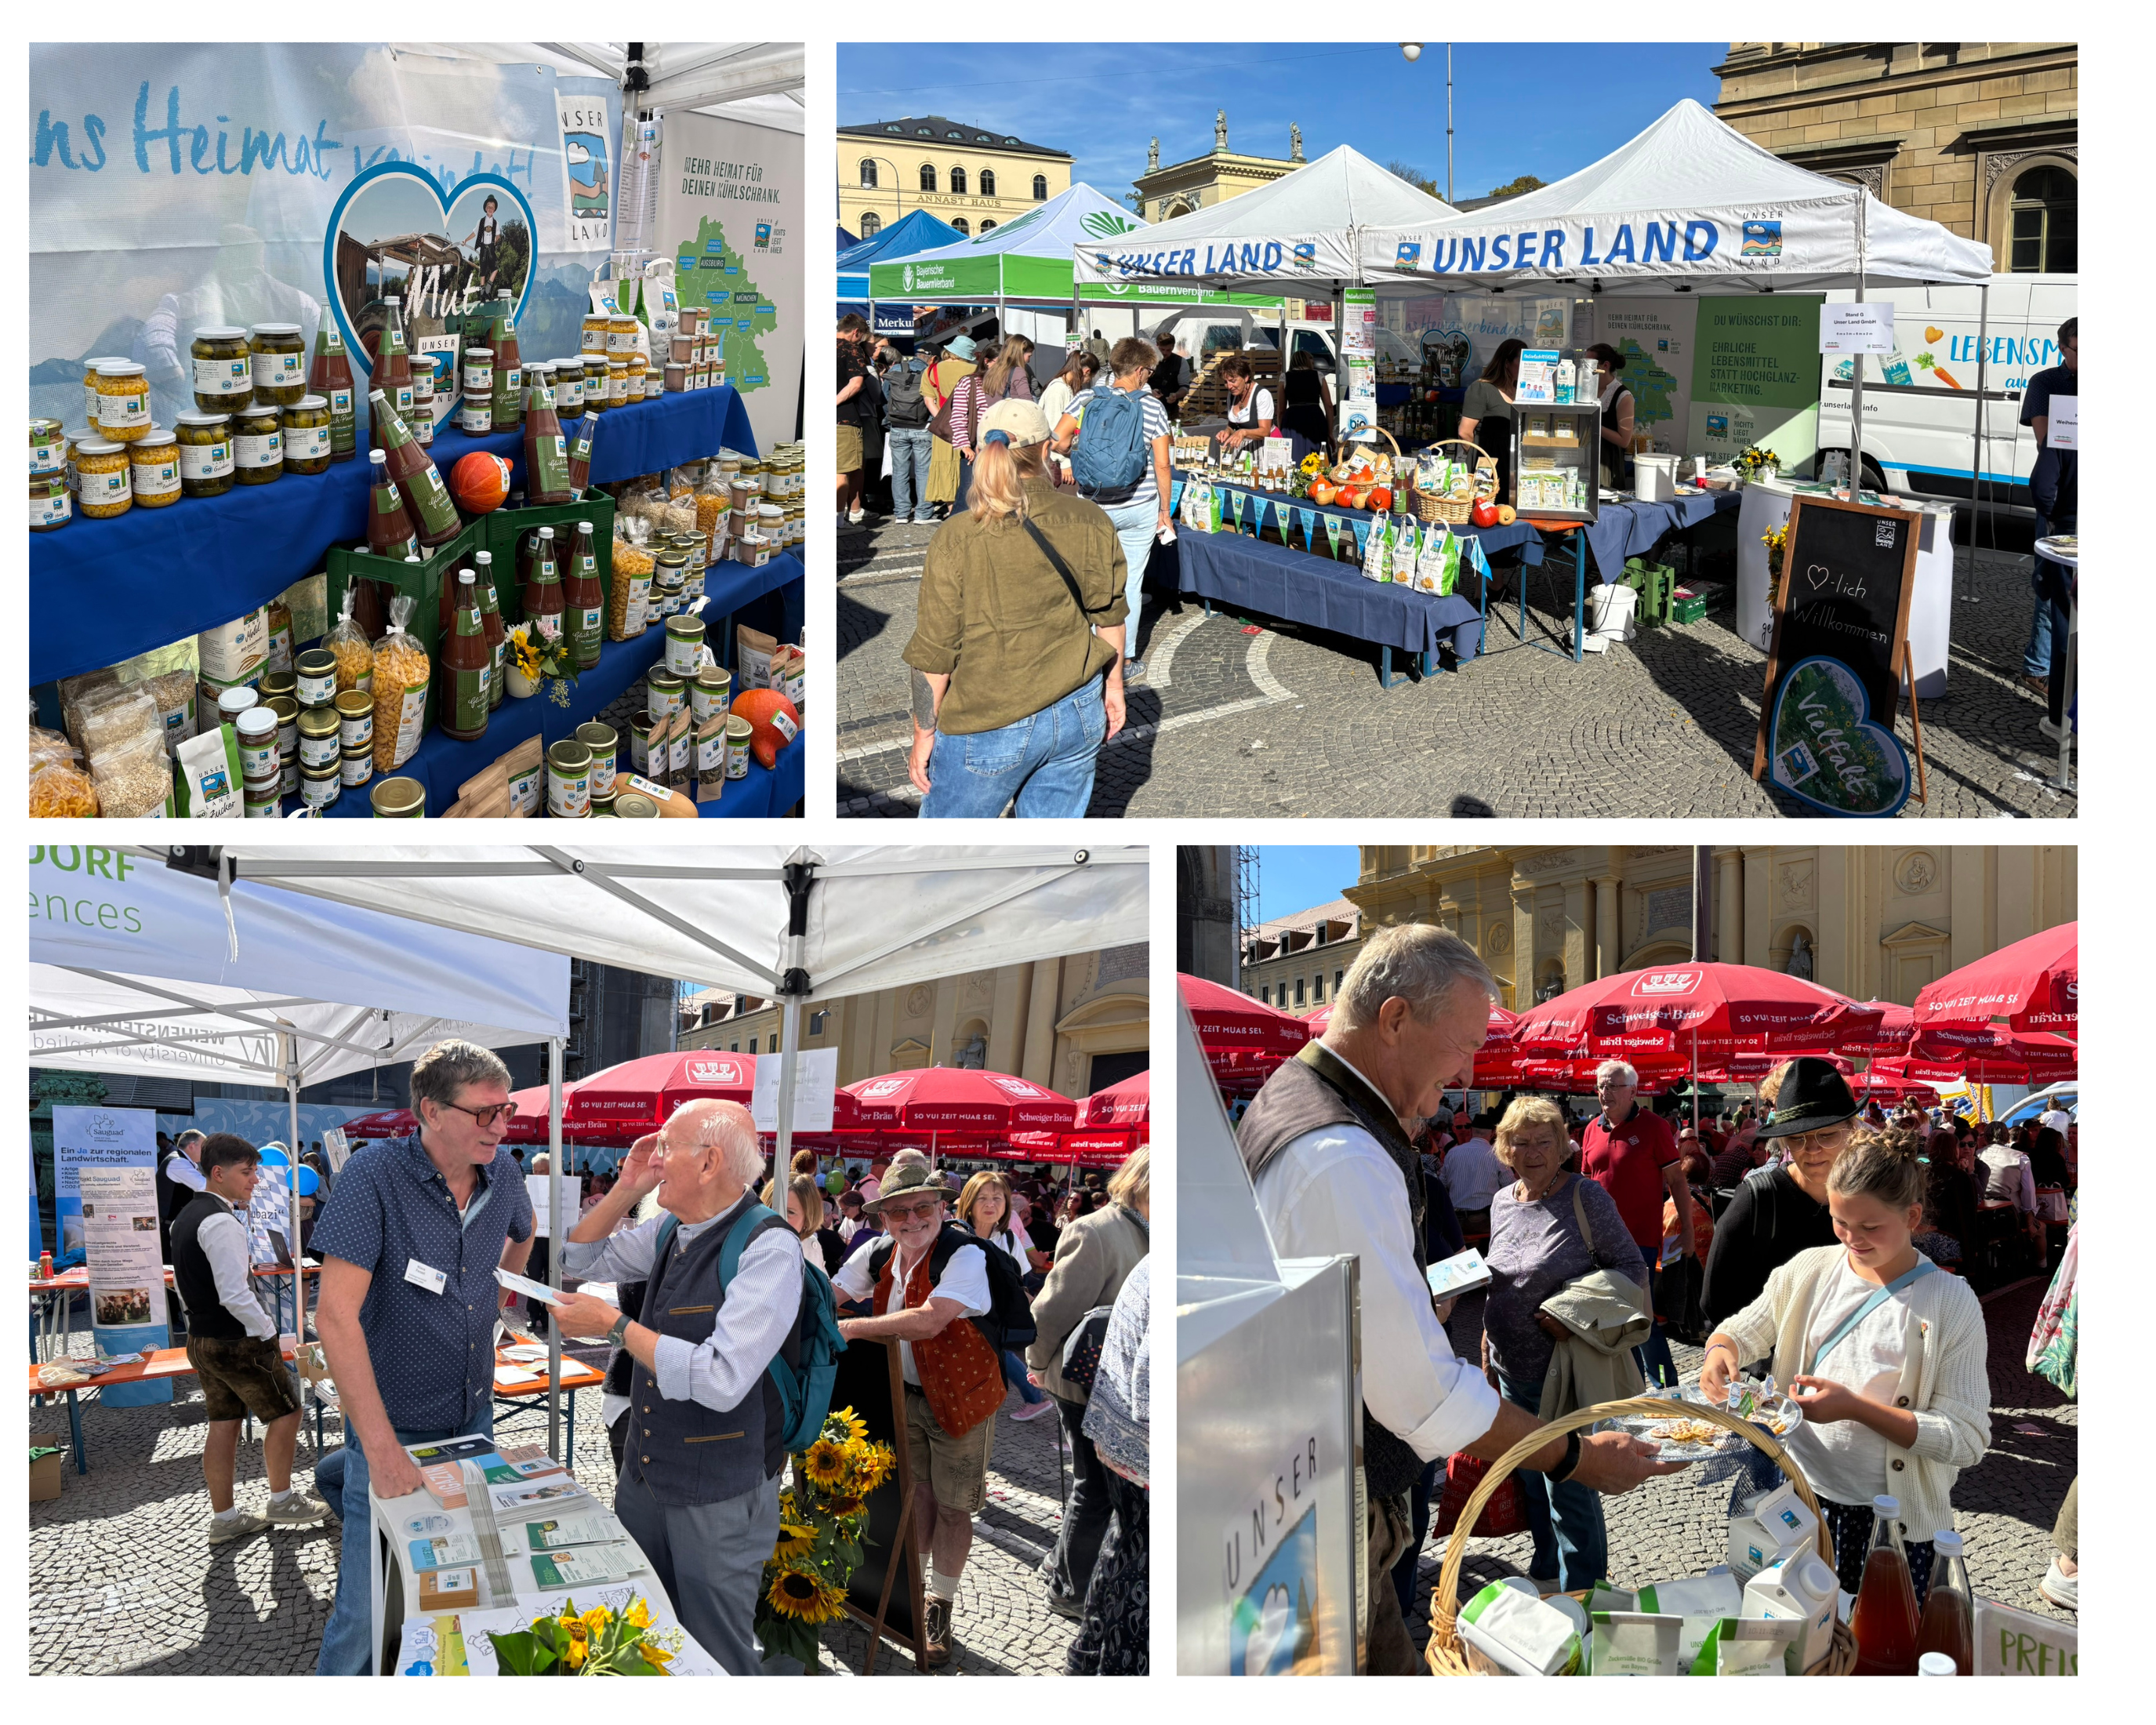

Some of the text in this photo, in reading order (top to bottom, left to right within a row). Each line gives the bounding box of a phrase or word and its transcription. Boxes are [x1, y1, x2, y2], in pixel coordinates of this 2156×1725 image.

[132, 80, 344, 181] Heimat
[684, 157, 763, 182] MEHR HEIMAT FÜR
[682, 178, 781, 204] DEINEN KÜHLSCHRANK.
[916, 194, 1002, 208] ANNAST HAUS
[1742, 210, 1784, 220] UNSER
[572, 223, 608, 241] LAND
[1432, 220, 1719, 274] UNSER LAND
[700, 259, 724, 268] AUGSBURG
[1117, 242, 1283, 275] UNSER LAND
[1739, 257, 1780, 266] LAND
[916, 265, 945, 276] Bayerischer
[405, 264, 481, 325] Mut
[1540, 301, 1563, 312] UNSER
[1629, 322, 1672, 332] KÜHLSCHRANK.
[1714, 314, 1802, 327] DU WÜNSCHST DIR:
[422, 339, 456, 351] UNSER
[1712, 342, 1757, 354] EHRLICHE
[1950, 335, 2063, 367] LEBENSM
[1711, 356, 1779, 369] LEBENSMITTEL
[1710, 369, 1800, 383] STATT HOCHGLANZ-
[2005, 376, 2029, 389] au
[1709, 381, 1762, 396] MARKETING.
[1733, 435, 1751, 445] NÄHER
[1704, 451, 1740, 460] WIR STEHE
[1794, 597, 1887, 644] Willkommen
[245, 622, 262, 643] Mehl
[1798, 743, 1816, 770] UNSER
[199, 764, 224, 779] UNSER
[1777, 758, 1793, 785] LAND
[206, 796, 230, 810] LAND
[1929, 1001, 1942, 1011] SO
[1958, 996, 1976, 1008] ZEIT
[1607, 1009, 1704, 1026] Schweiger Bräu
[1770, 1015, 1787, 1023] ZEIT
[1936, 1030, 2002, 1044] Schweiger Bräu
[1115, 1104, 1129, 1113] VUI
[1129, 1103, 1145, 1112] ZEIT
[1018, 1113, 1073, 1124] Schweiger Bräu
[1226, 1436, 1317, 1589] UNSER
[1777, 1506, 1790, 1516] UNSER
[1792, 1523, 1803, 1534] LAND
[1748, 1542, 1763, 1552] UNSER
[1646, 1658, 1662, 1666] Grüße
